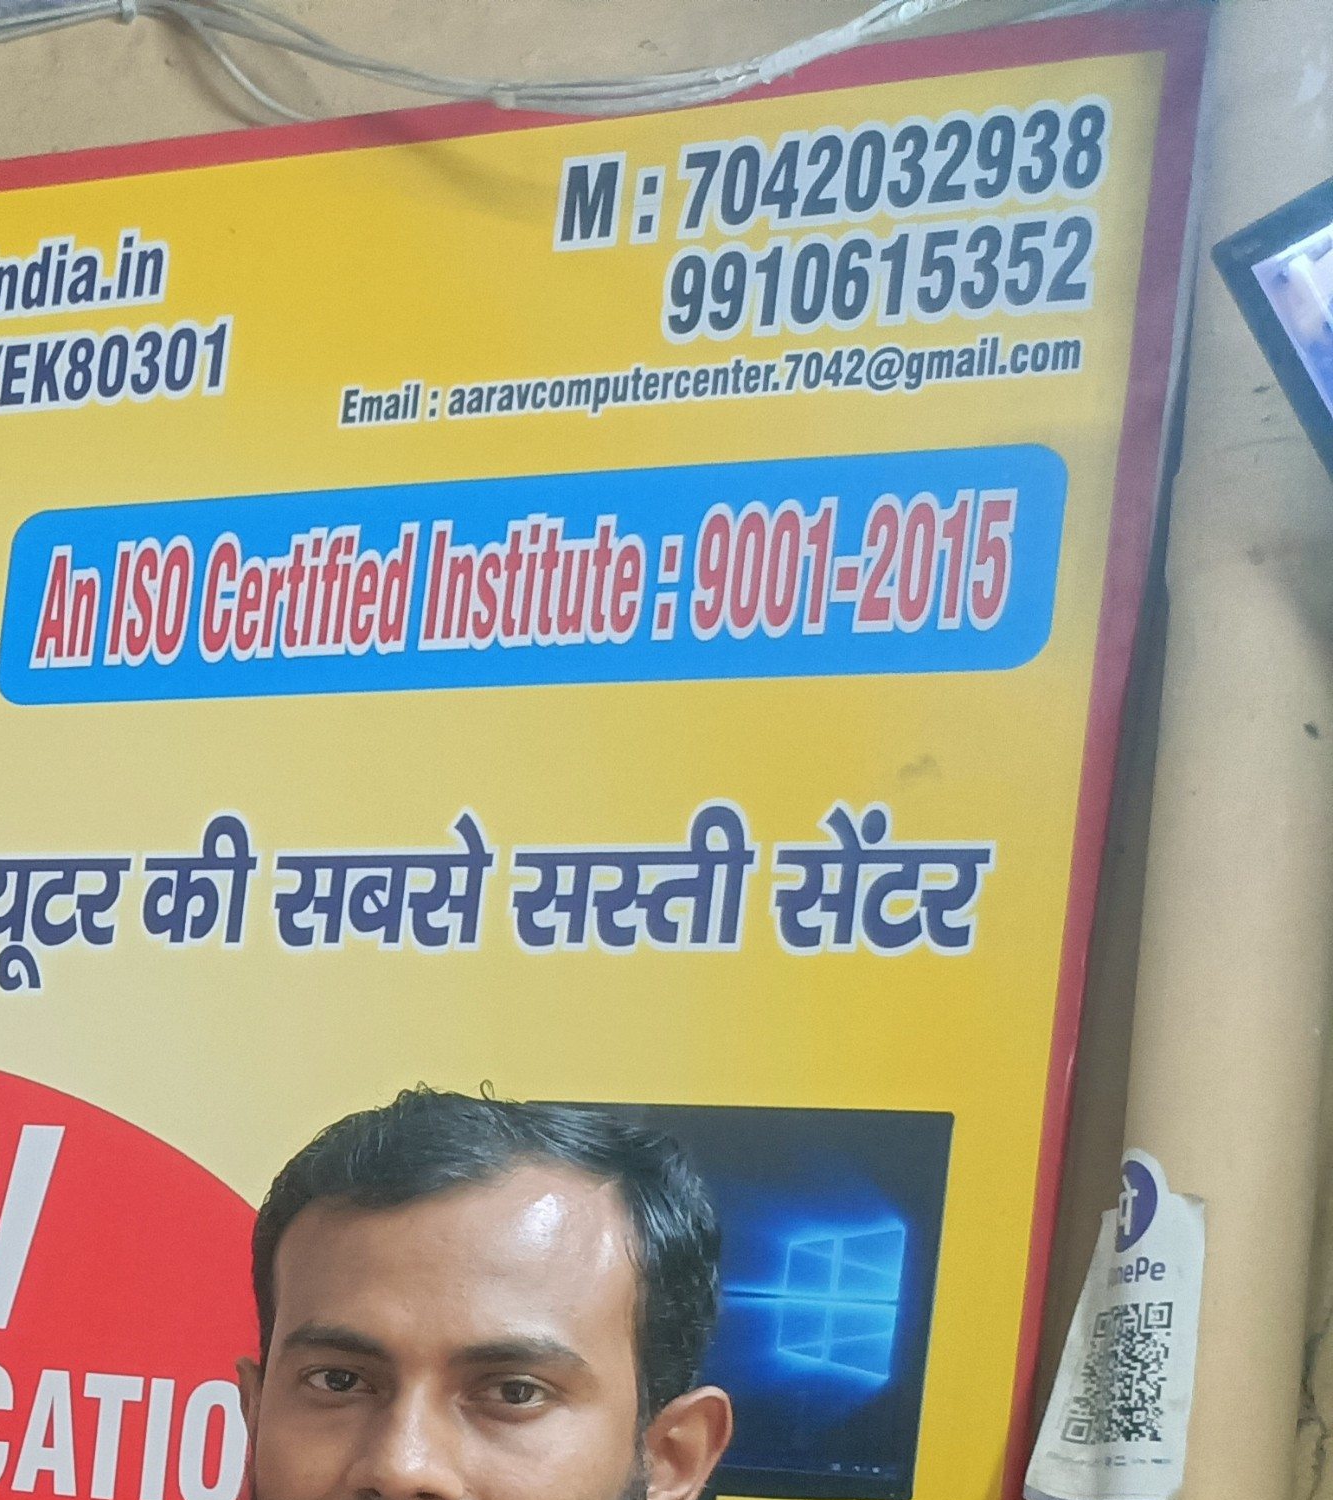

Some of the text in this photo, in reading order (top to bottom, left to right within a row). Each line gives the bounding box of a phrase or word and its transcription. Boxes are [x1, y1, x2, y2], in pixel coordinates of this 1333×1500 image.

[559, 161, 618, 243] M
[682, 104, 1105, 232] 7042032938
[668, 217, 1093, 334] 9910615352
[340, 385, 418, 425] Email
[447, 337, 1081, 416] aaravcomputercenter.7042@gmail.com
[36, 555, 99, 661] An
[108, 542, 188, 658] ISO
[201, 530, 415, 655] Certified
[423, 522, 641, 643] Institute
[694, 497, 1013, 633] 9001-2015
[143, 815, 257, 945] की
[275, 812, 494, 947] सबसे
[512, 804, 755, 947] सस्ती
[775, 806, 991, 948] सेंटर
